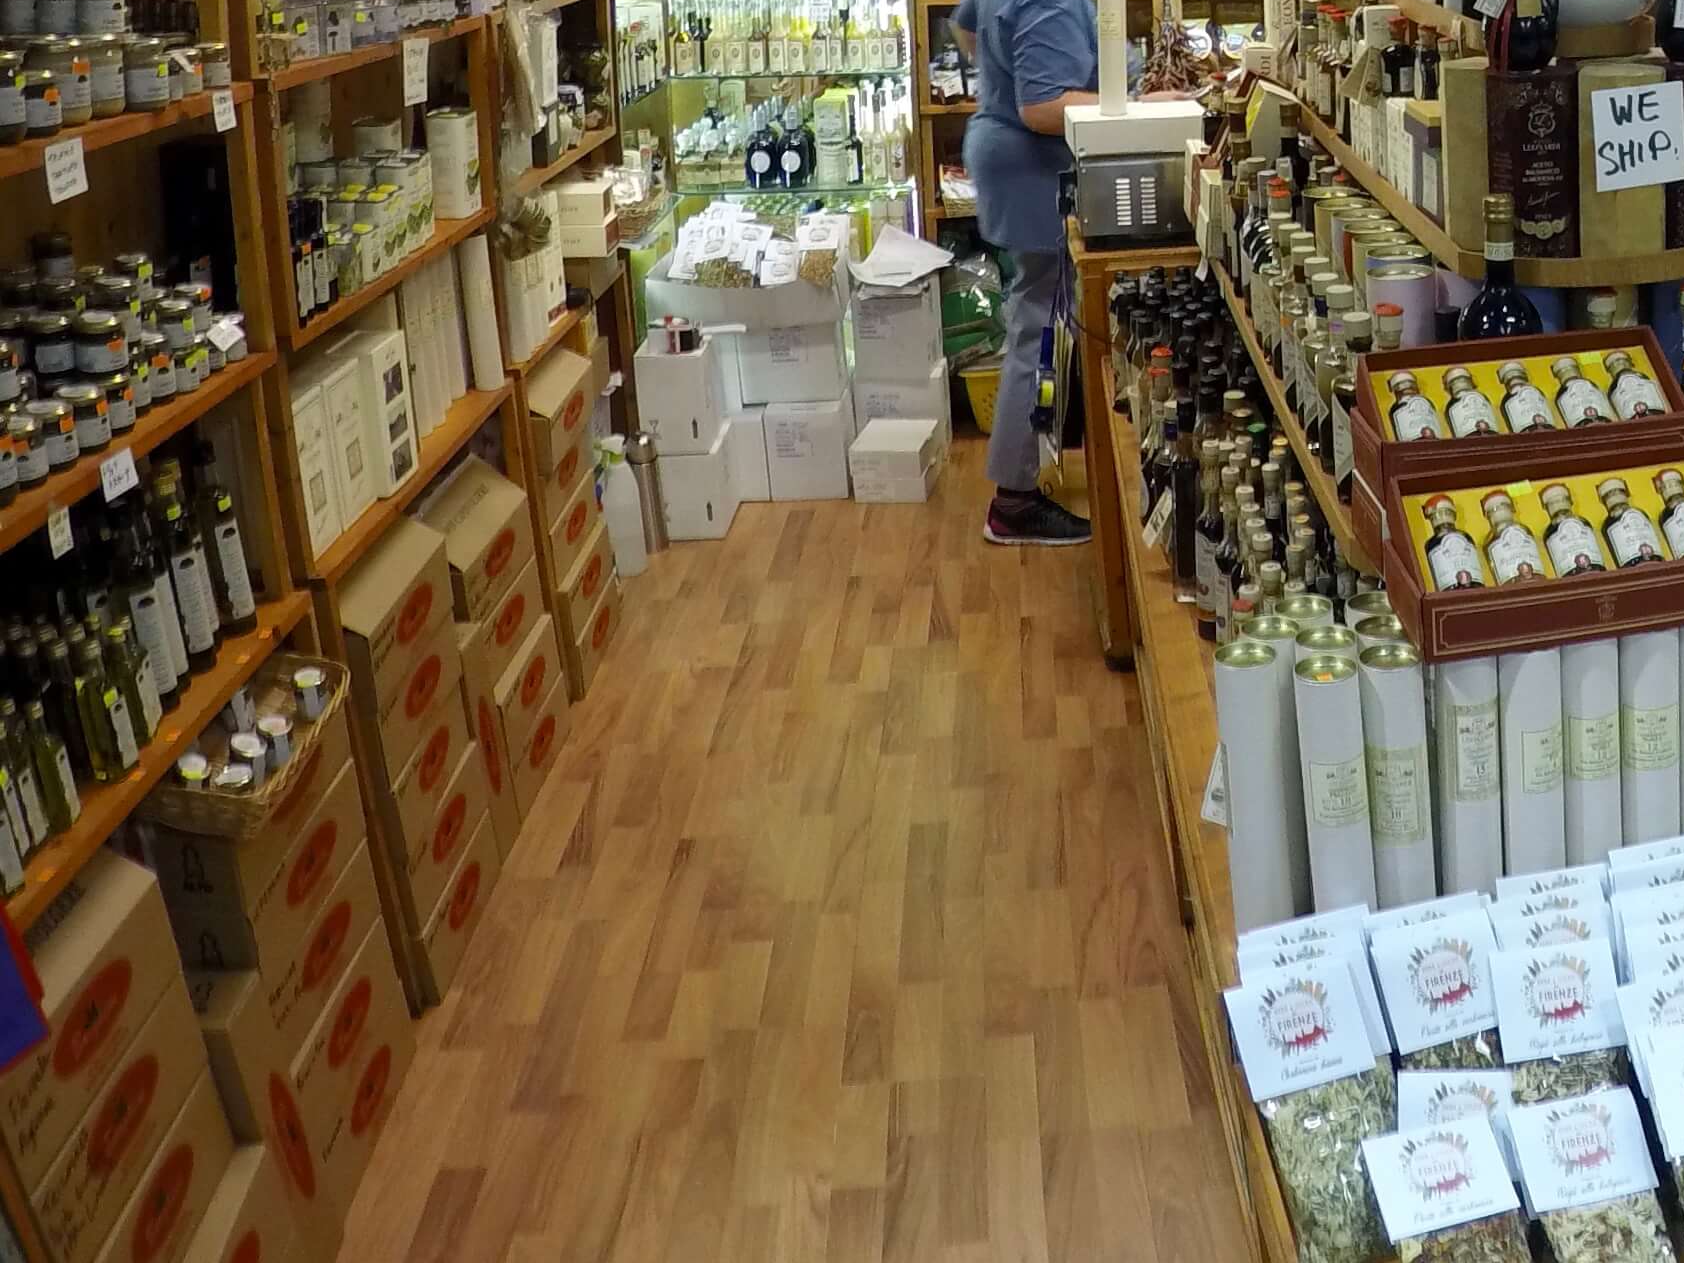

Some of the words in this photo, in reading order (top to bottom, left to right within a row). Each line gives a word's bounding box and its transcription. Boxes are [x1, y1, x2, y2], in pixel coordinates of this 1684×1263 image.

[1609, 90, 1660, 126] WE
[1425, 969, 1463, 989] FIRENZE
[1539, 986, 1578, 1002] FIRENZE
[1277, 1012, 1319, 1033] FIRENZE
